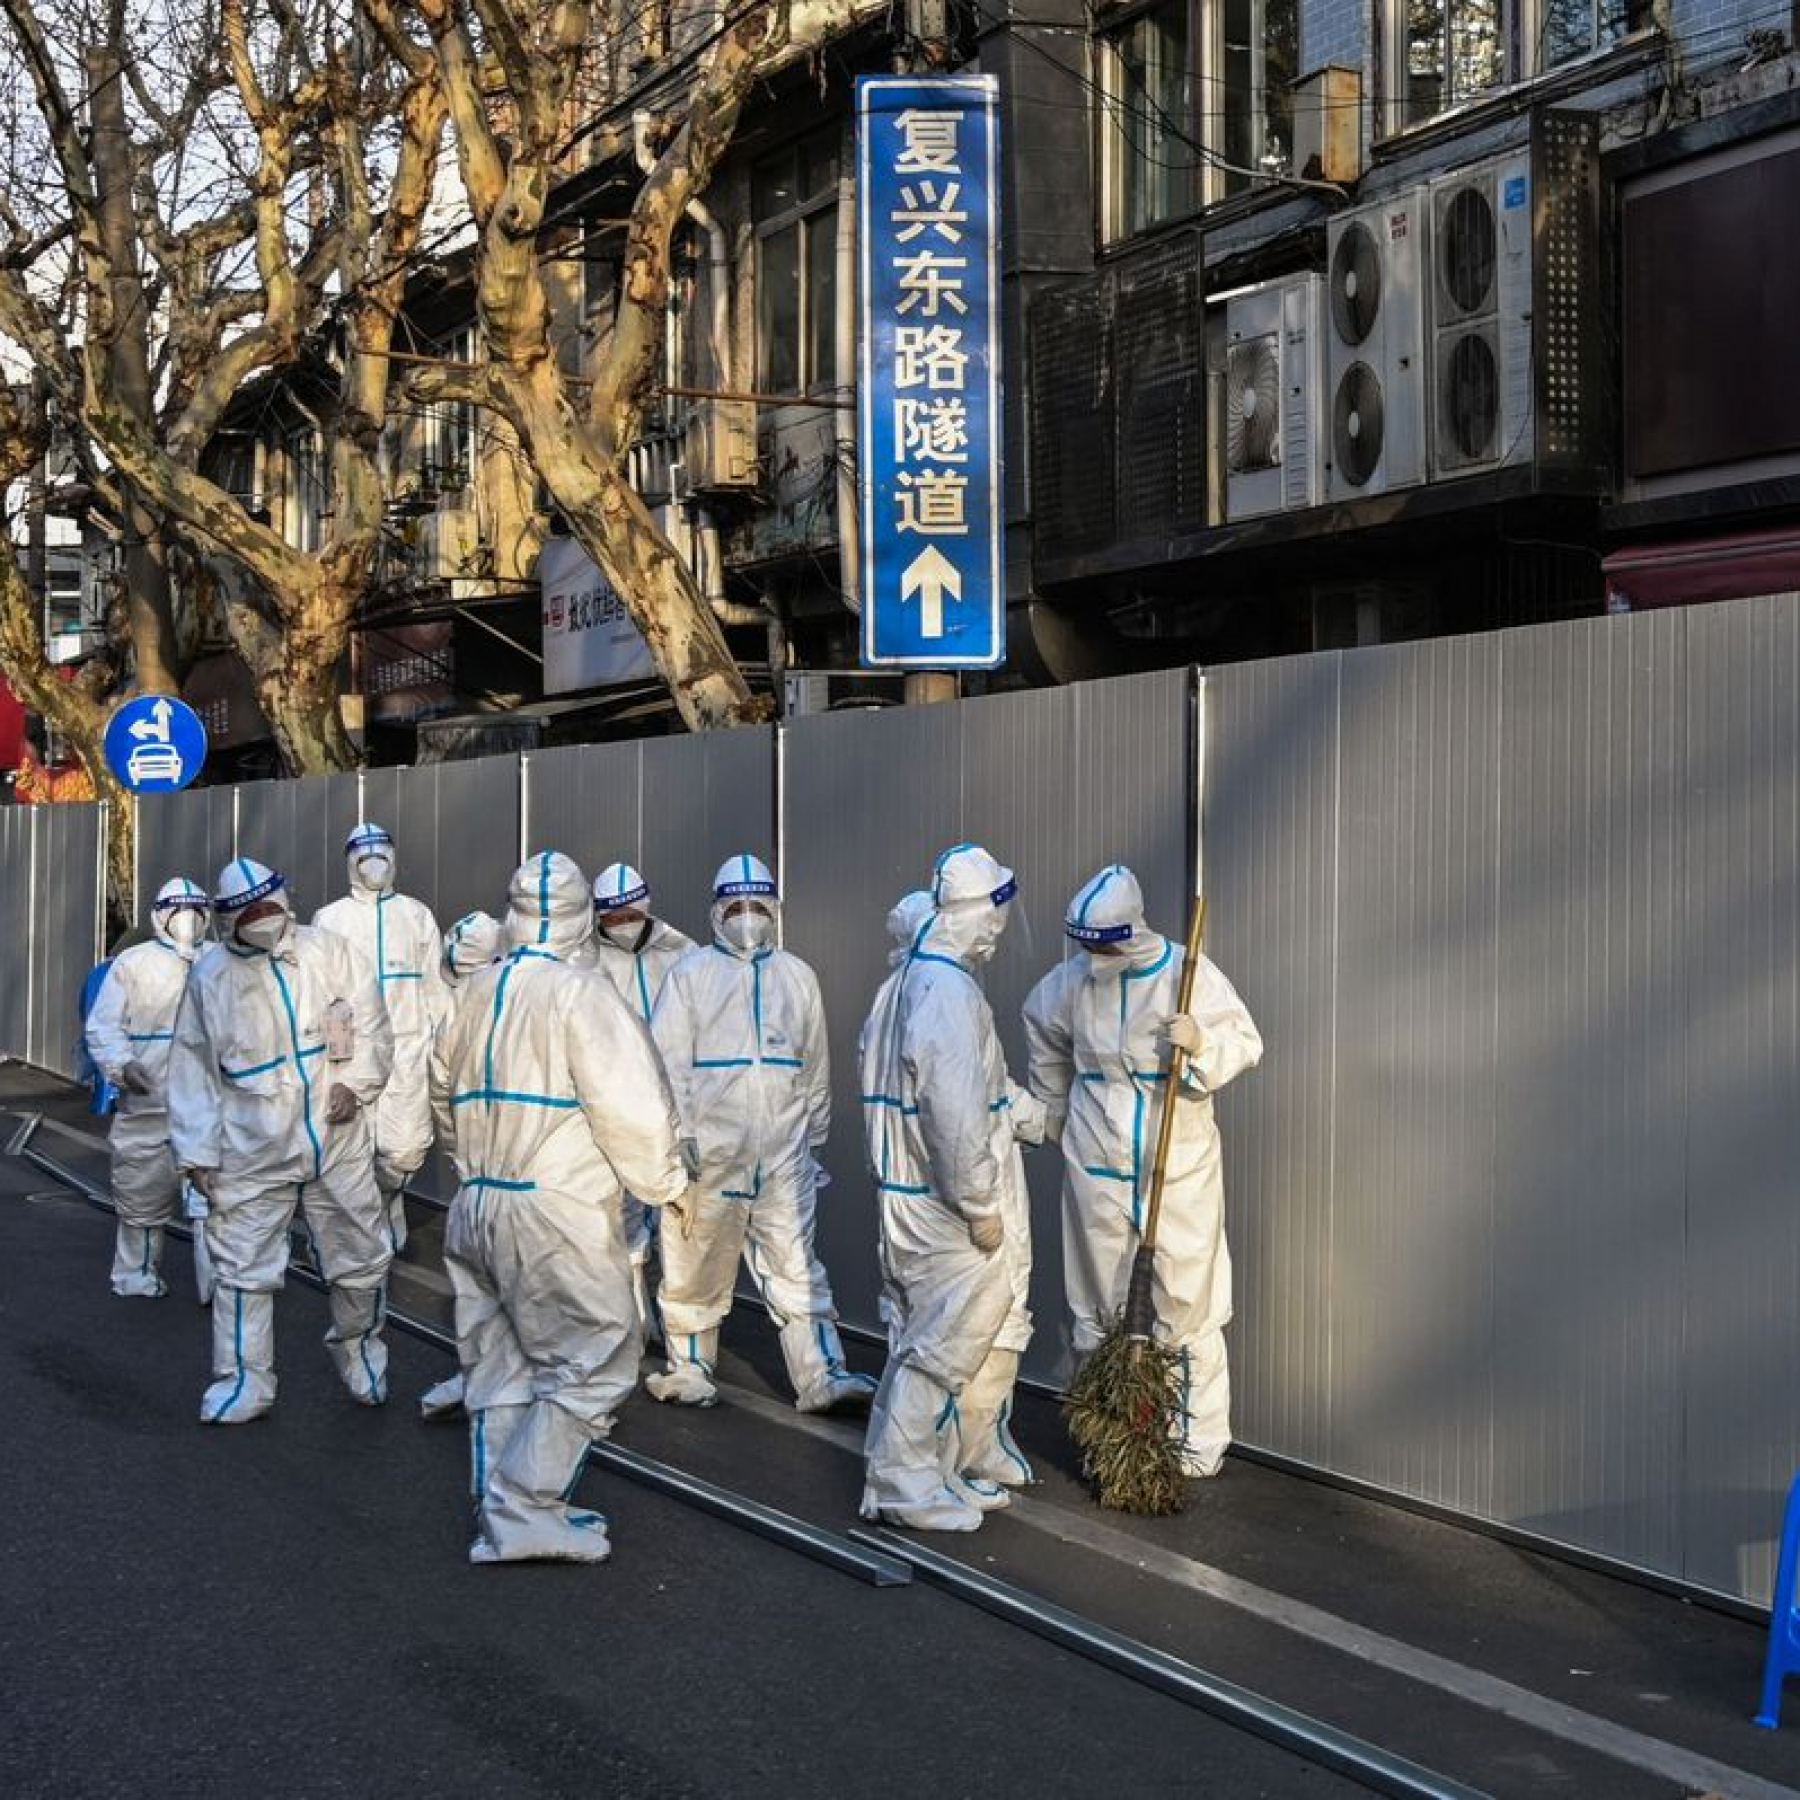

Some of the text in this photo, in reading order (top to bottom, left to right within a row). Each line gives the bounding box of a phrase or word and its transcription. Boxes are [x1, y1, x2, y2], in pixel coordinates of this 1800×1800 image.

[891, 108, 969, 536] 复兴东路隧道
